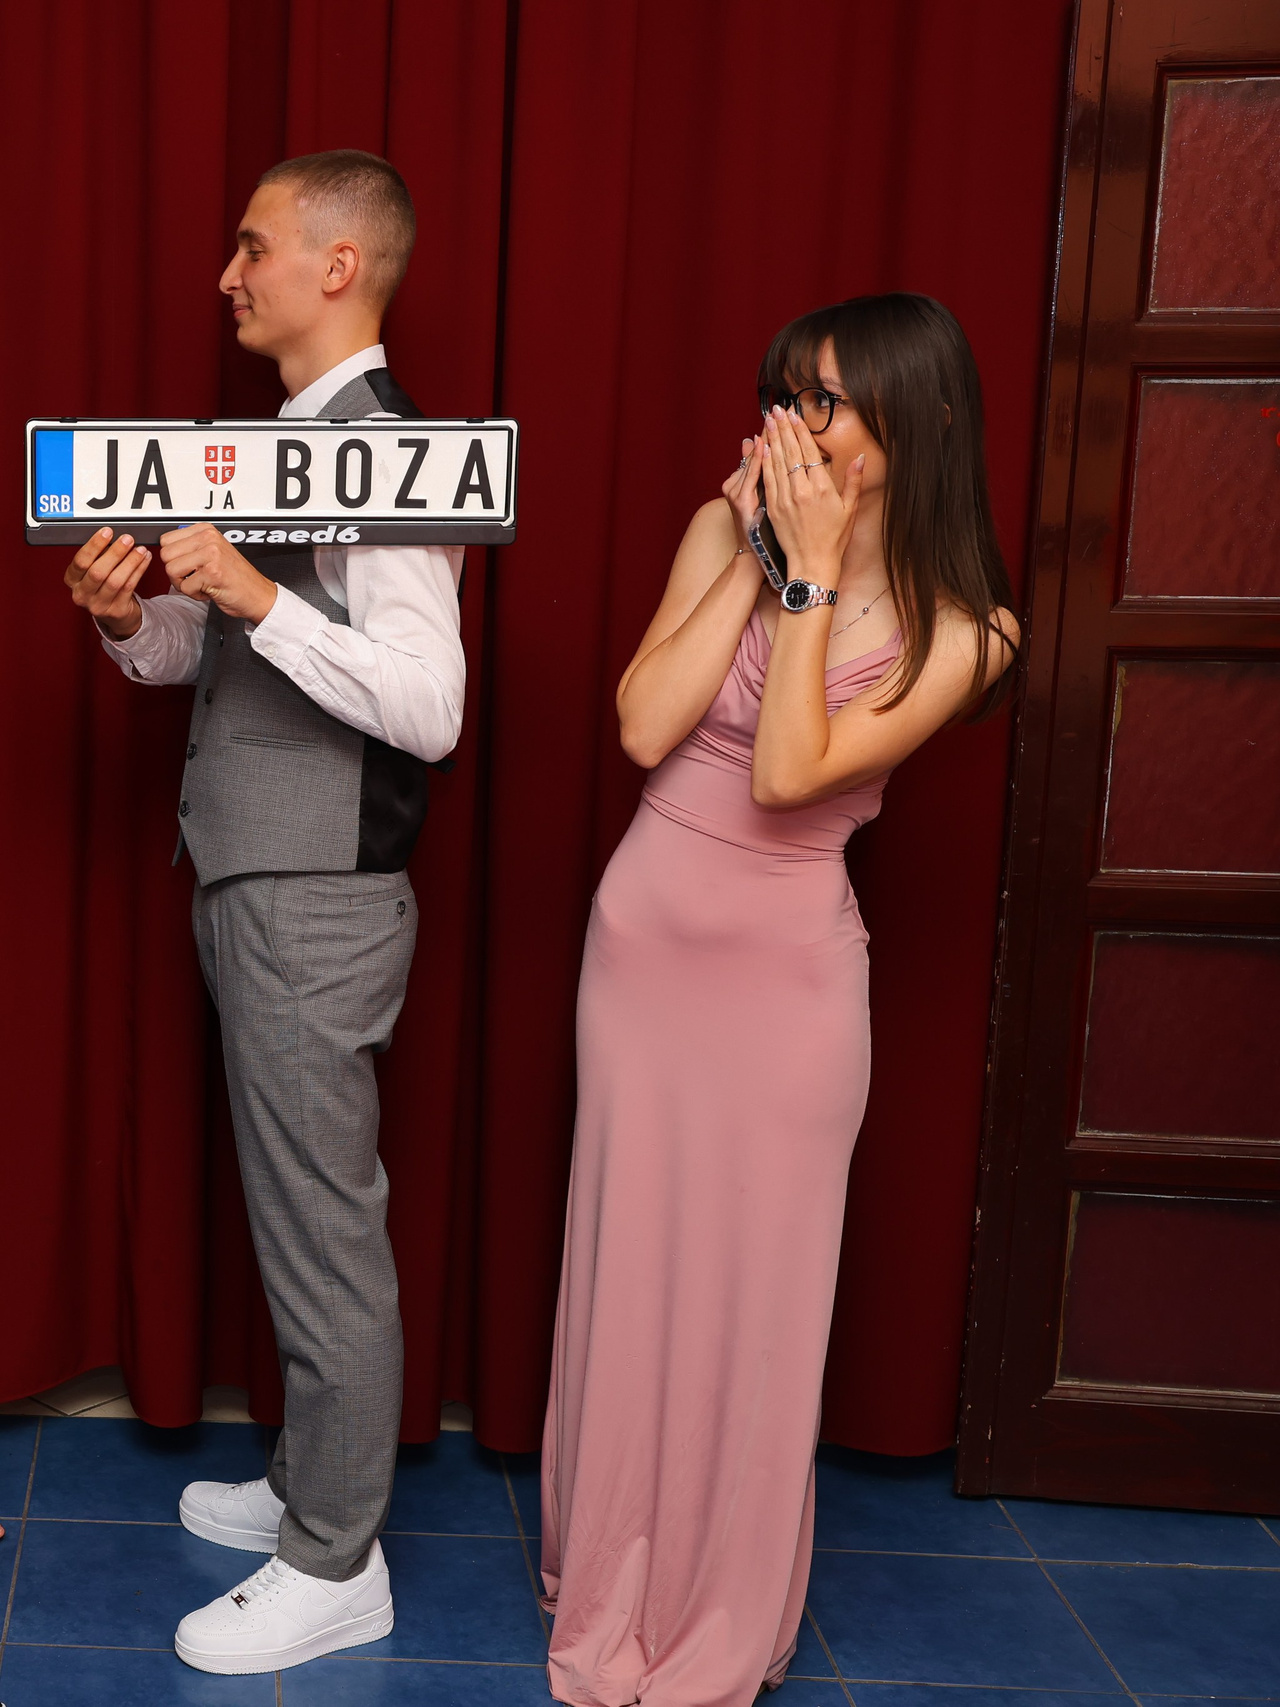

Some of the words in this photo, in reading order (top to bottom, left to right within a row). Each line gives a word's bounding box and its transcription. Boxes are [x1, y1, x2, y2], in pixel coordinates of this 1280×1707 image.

[86, 438, 174, 510] JA
[275, 438, 495, 510] BOZA
[39, 494, 71, 513] SRB
[204, 490, 235, 510] JA
[223, 525, 361, 544] ozaed6
